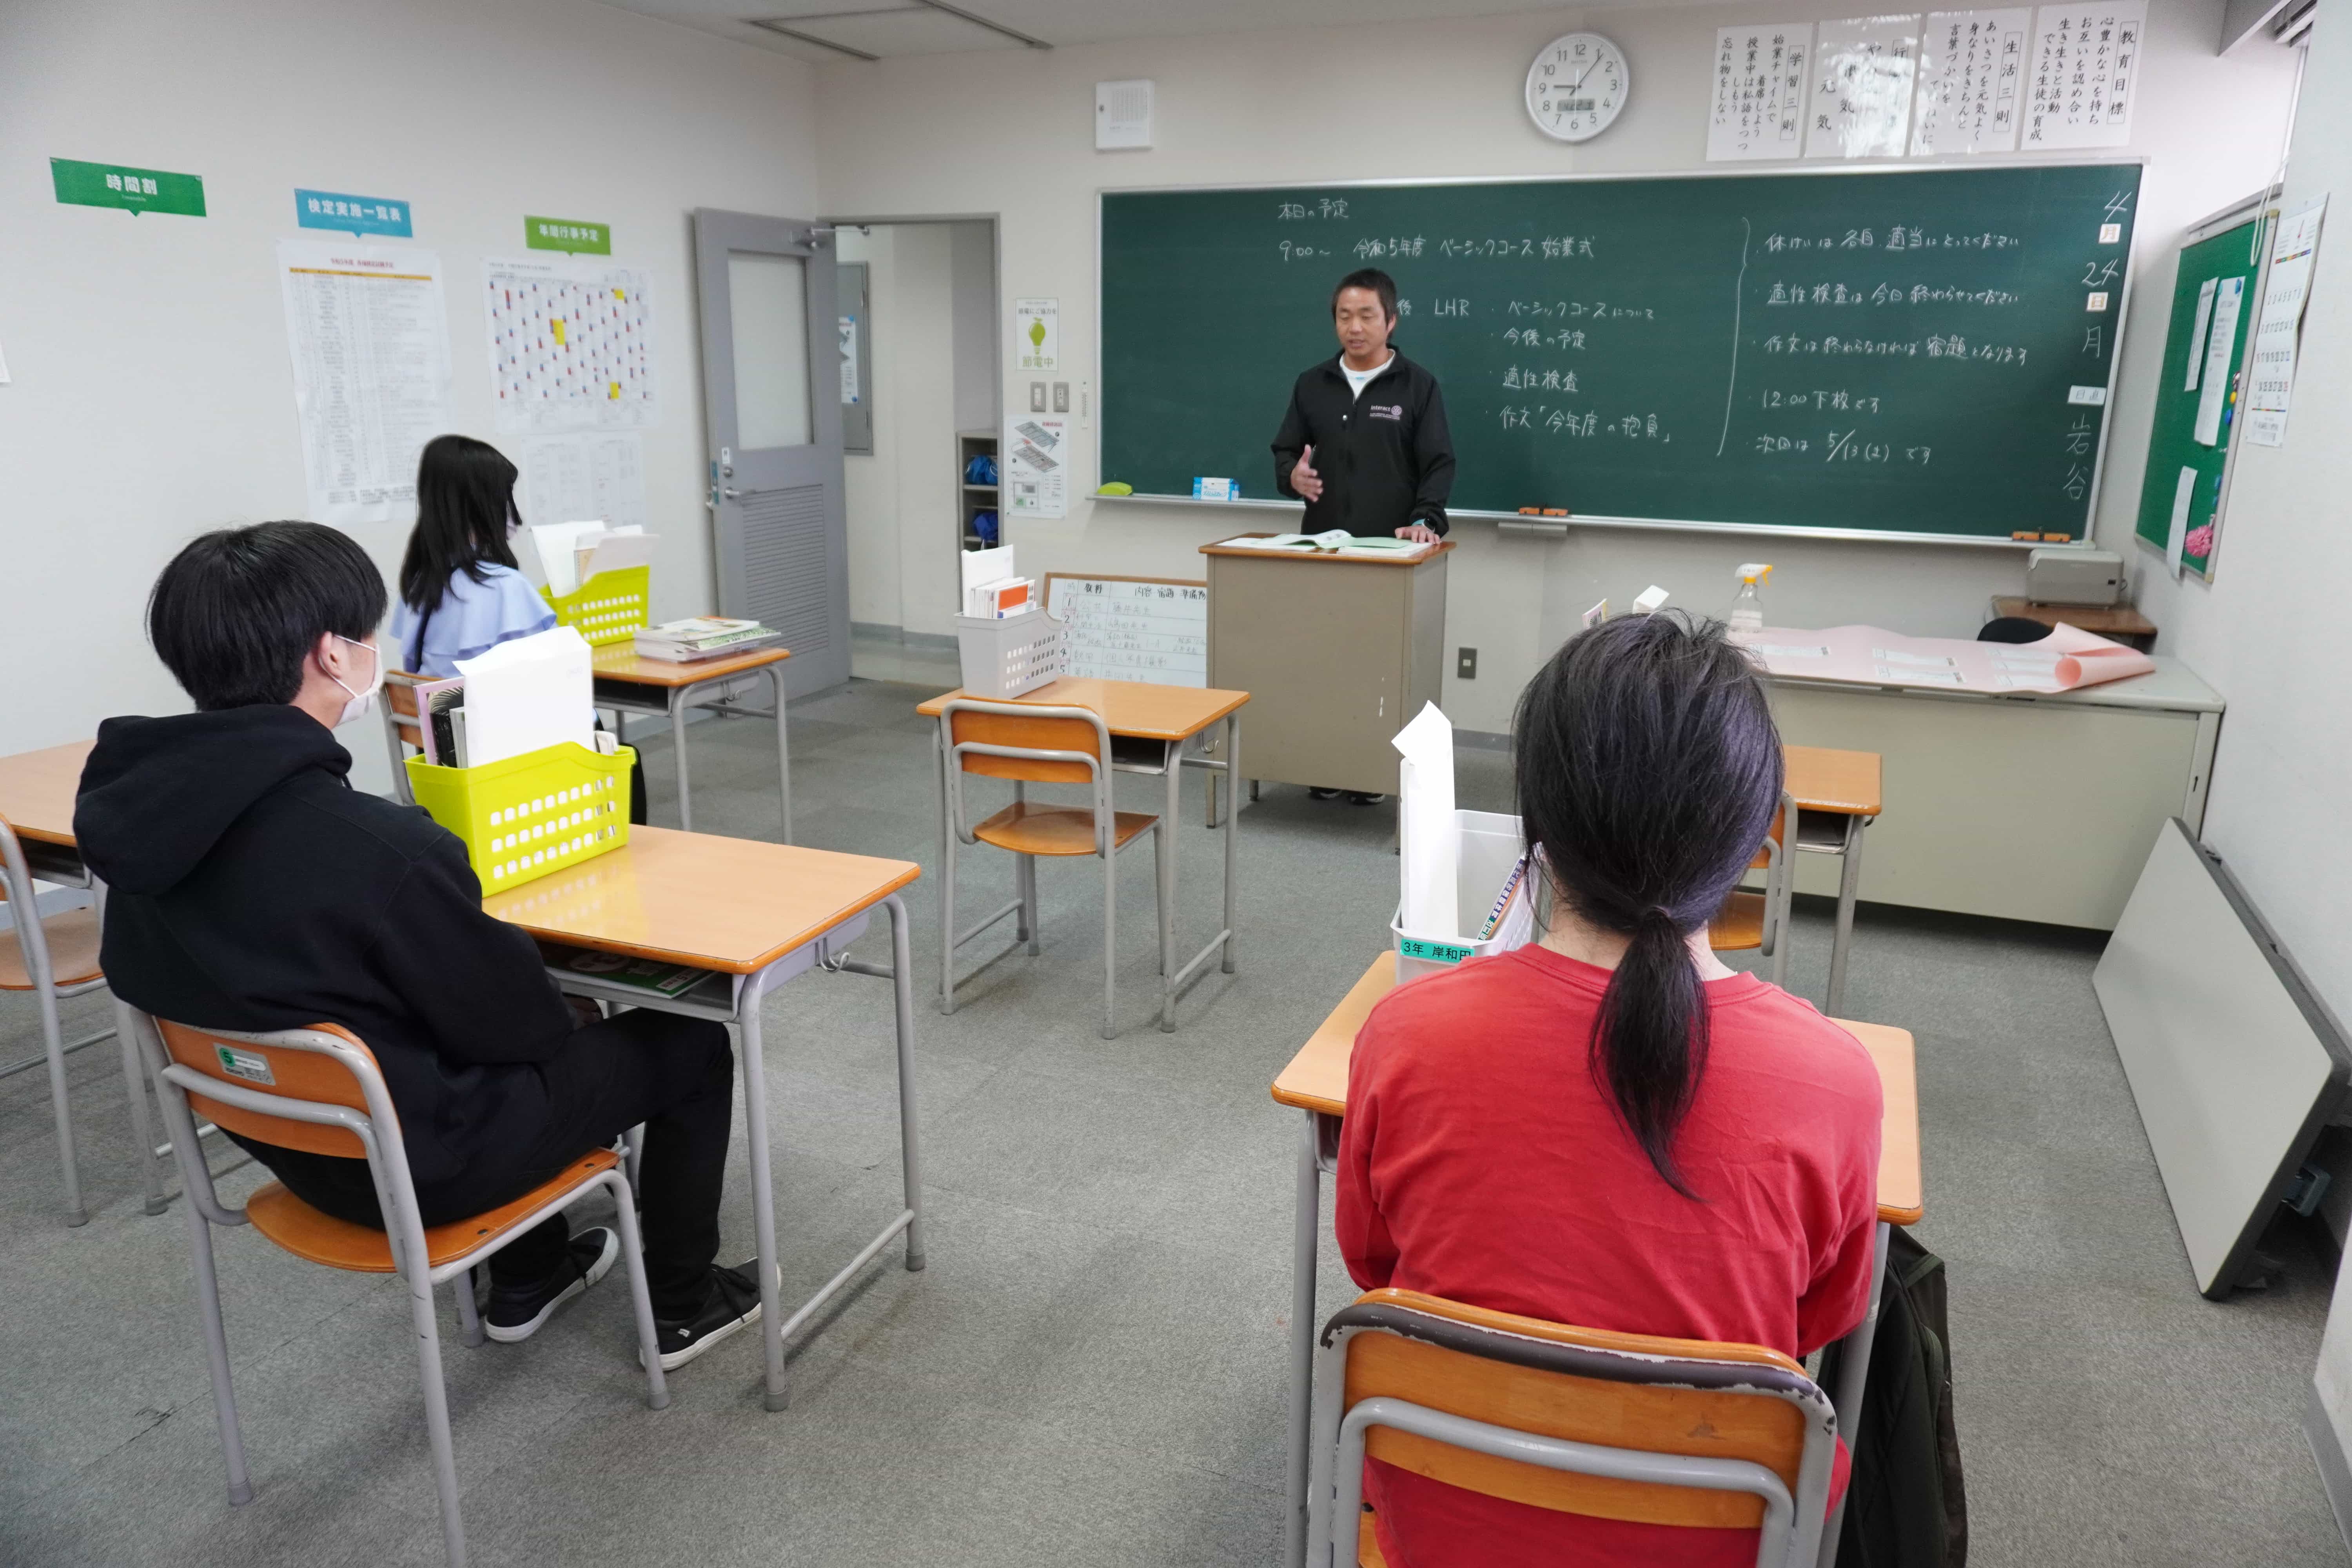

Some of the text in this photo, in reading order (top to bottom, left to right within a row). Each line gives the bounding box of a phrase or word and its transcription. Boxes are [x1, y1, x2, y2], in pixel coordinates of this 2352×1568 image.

[1557, 50, 1567, 62] 11
[1574, 44, 1586, 55] 12
[1543, 64, 1555, 75] 10
[1605, 61, 1613, 73] 2
[1942, 23, 1962, 103] 言葉づかいを
[2047, 17, 2071, 114] 生き生きと活動
[2068, 17, 2092, 124] お互いを認め合い
[2089, 17, 2114, 124] 心豊かな心を持ち
[2109, 30, 2136, 116] 教育目標
[1610, 79, 1617, 91] 3
[1716, 37, 1733, 124] 忘れ物をしない
[1767, 34, 1784, 123] 始業チャイムで
[1958, 22, 1979, 129] 身なりをきちんと
[1975, 20, 1996, 141] あいさつを元気よく
[1995, 40, 2018, 123] 生活三則
[2029, 33, 2055, 141] できる生徒の育成
[1539, 82, 1546, 94] 9
[1731, 77, 1740, 113] しもう
[1738, 36, 1759, 150] 授業中は私語をつつ
[1782, 52, 1802, 132] 学習三則
[1543, 100, 1550, 111] 8
[1602, 97, 1611, 109] 4
[1753, 74, 1766, 138] 着席しよう
[1816, 78, 1836, 130] 元気
[1555, 114, 1562, 125] 7
[1570, 118, 1579, 129] 6
[1590, 113, 1597, 123] 5
[105, 173, 158, 195] 時間割
[308, 197, 401, 222] 検定実施一覧表
[1278, 197, 1349, 220] 本日の予定
[539, 223, 598, 242] 年間行事予定
[1353, 233, 1426, 260] 令和5年度
[1440, 238, 1534, 257] ベーシックコース
[1541, 235, 1595, 260] 始業式
[2082, 190, 2132, 358] 4 月 24 日 月
[1434, 298, 1469, 316] LHR
[1508, 301, 1655, 319] ベーシックコースについて
[1503, 327, 1586, 350] 今後の予定
[1022, 356, 1053, 368] 節電中
[1502, 363, 1579, 392] 適性検査
[2063, 413, 2092, 500] 岩谷
[1083, 583, 1102, 594] 教科
[1064, 614, 1070, 624] 2
[1063, 630, 1068, 640] 3
[1060, 647, 1067, 657] 4
[1059, 664, 1066, 673] 5
[1404, 942, 1424, 955] 3年
